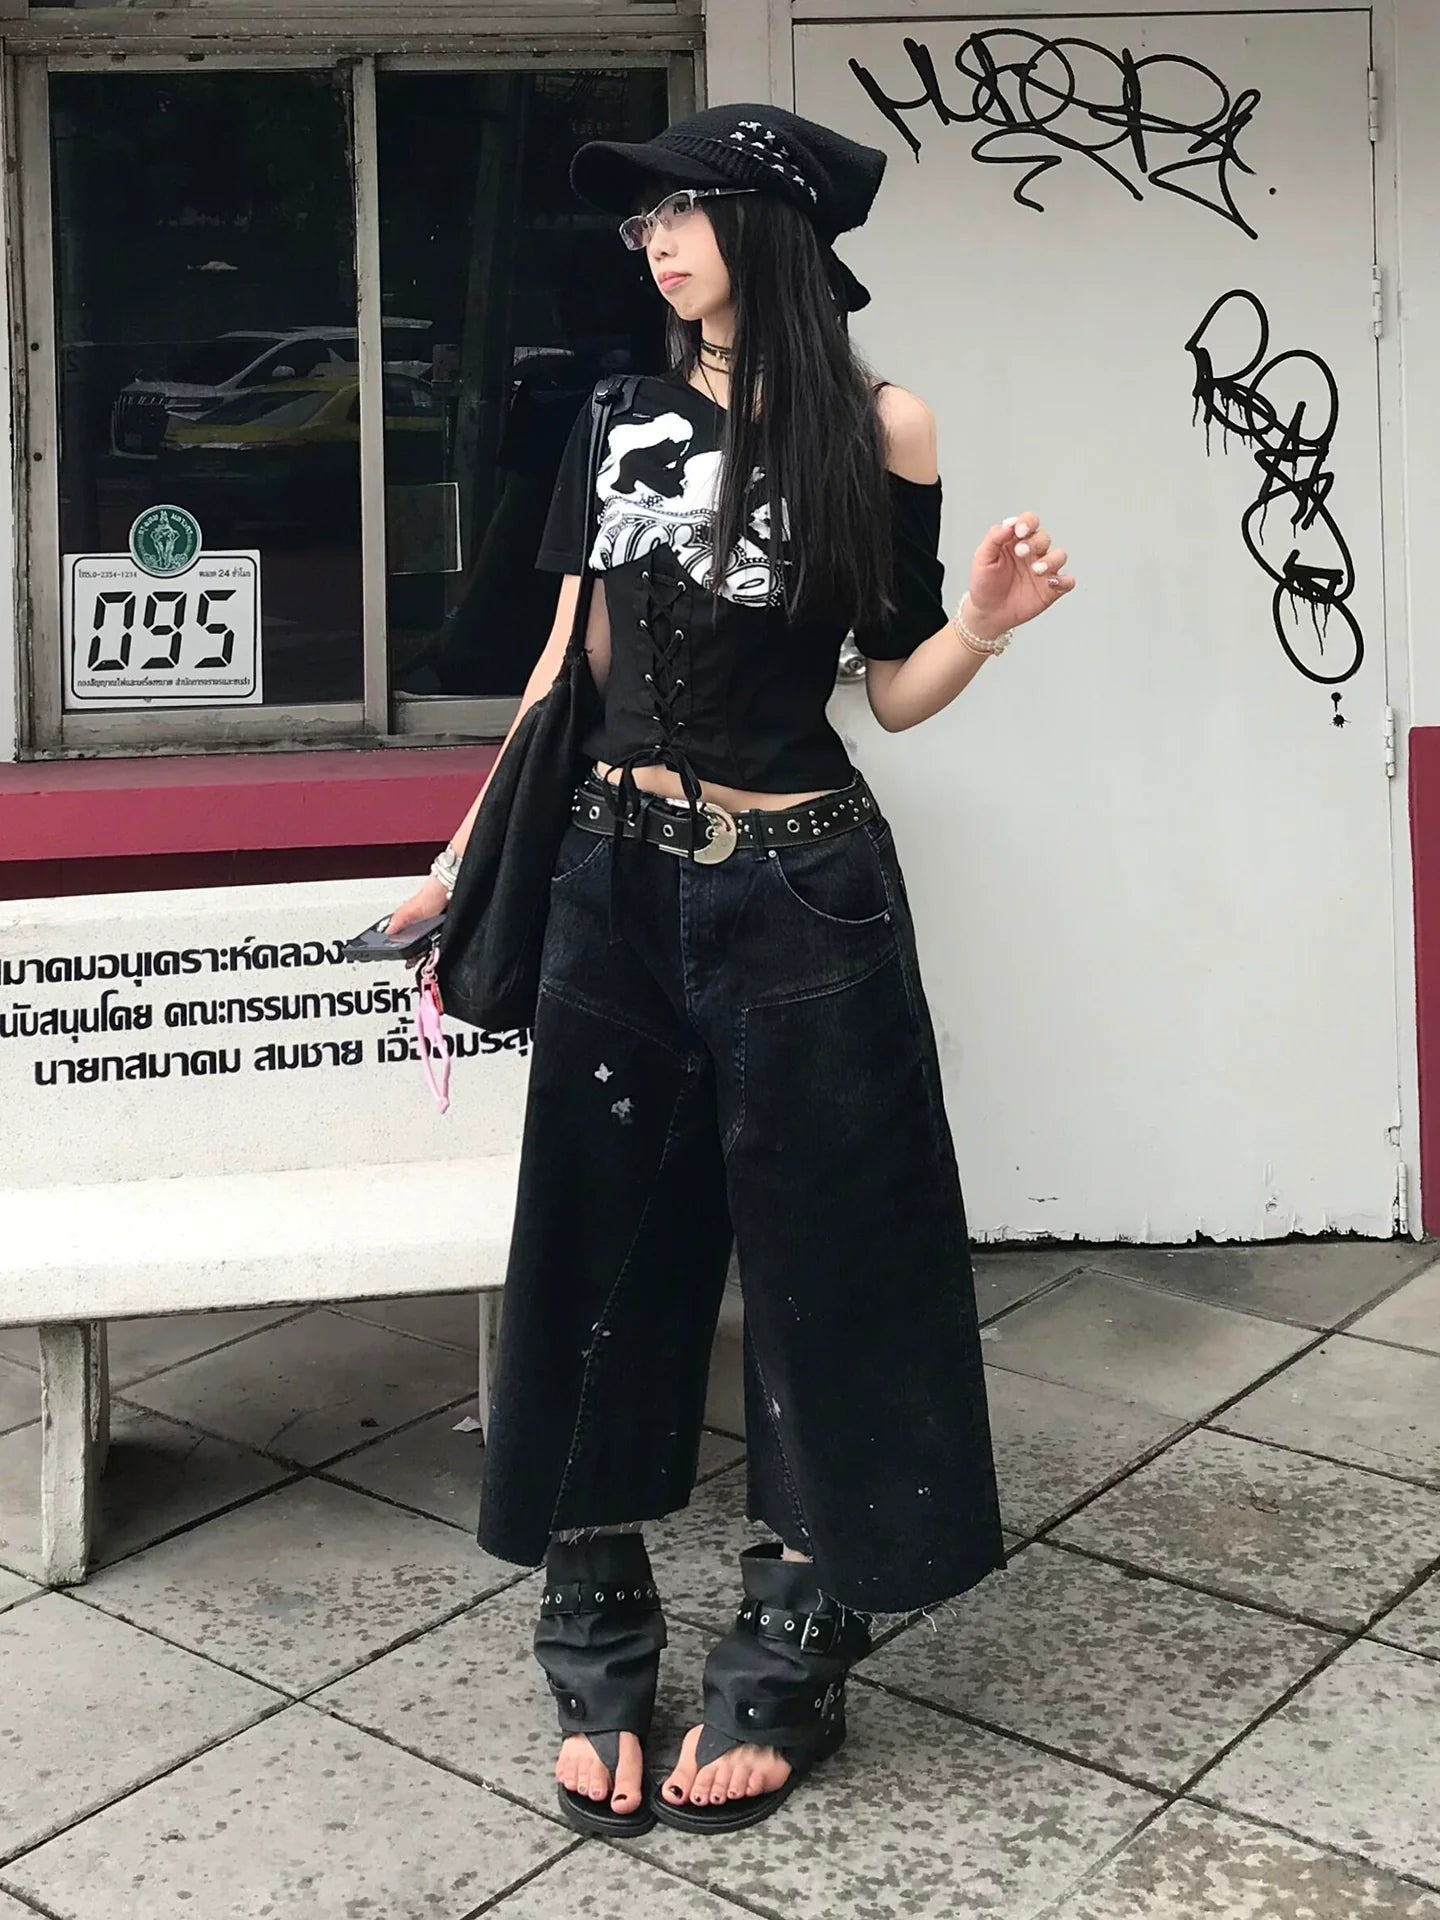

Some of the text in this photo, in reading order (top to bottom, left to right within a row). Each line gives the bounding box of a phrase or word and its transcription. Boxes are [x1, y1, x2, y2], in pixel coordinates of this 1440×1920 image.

[218, 569, 230, 578] 24
[87, 589, 237, 672] 095
[0, 936, 398, 987] มาคมอนุเคราะห์คลอง
[34, 1046, 241, 1086] นายกสมาคม
[254, 1038, 363, 1072] สมชาย
